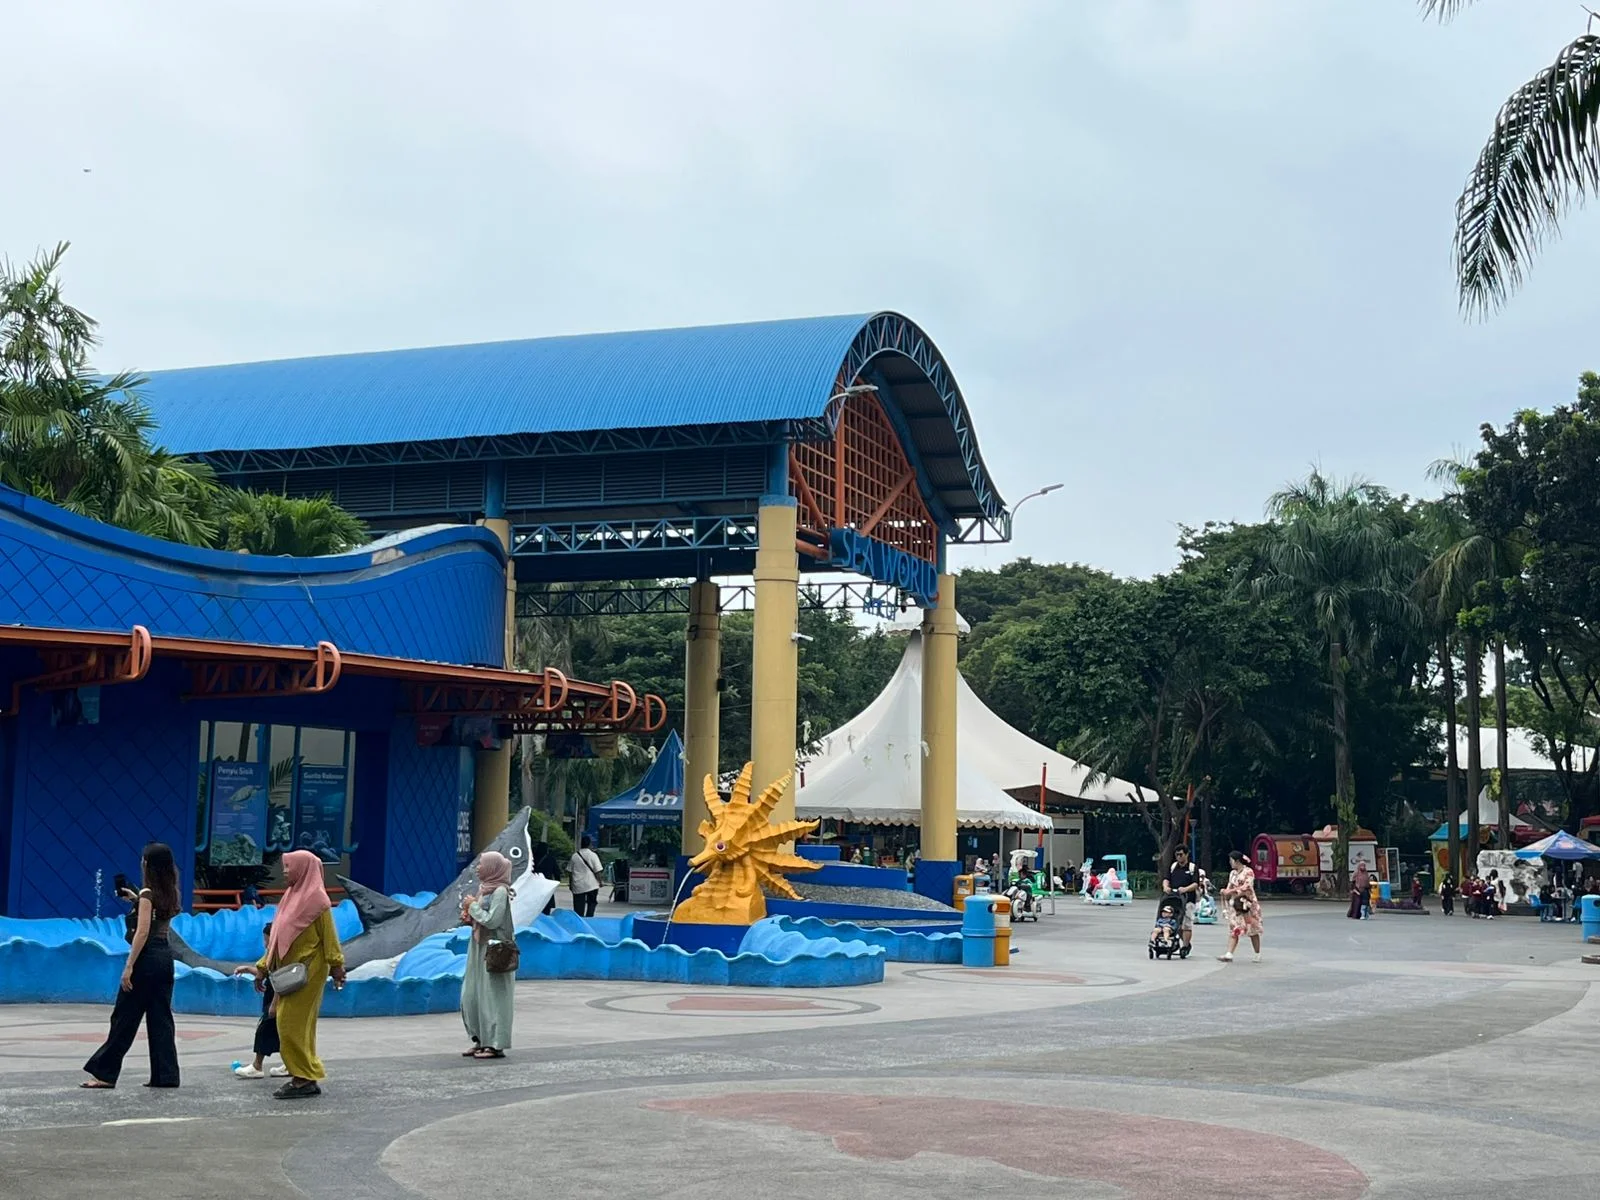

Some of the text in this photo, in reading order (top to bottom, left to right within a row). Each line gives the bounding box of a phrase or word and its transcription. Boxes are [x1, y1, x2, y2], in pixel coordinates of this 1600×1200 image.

[842, 529, 938, 610] SEA WORLD
[636, 787, 678, 806] btn
